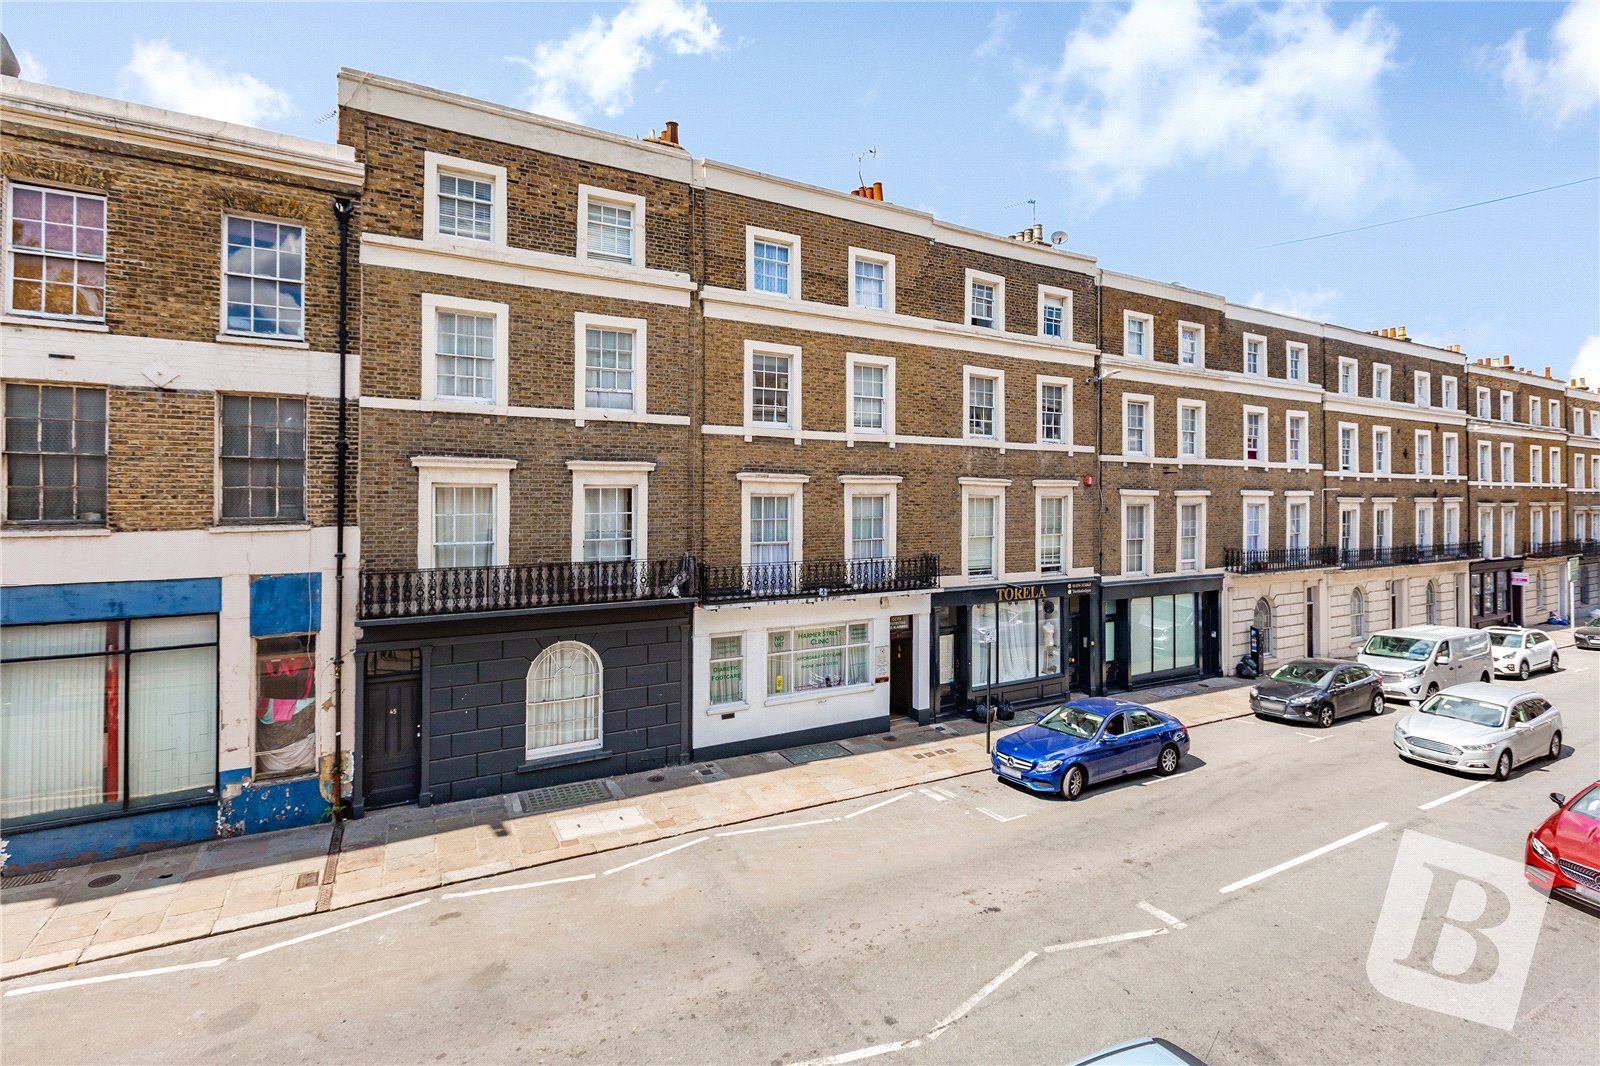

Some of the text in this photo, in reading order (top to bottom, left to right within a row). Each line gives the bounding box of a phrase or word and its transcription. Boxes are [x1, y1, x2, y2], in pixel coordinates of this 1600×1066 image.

[996, 585, 1047, 602] TORELA
[798, 630, 841, 640] HARMER STREET
[810, 638, 830, 646] CLINIC
[713, 665, 739, 673] DIABETIC
[711, 673, 741, 681] FOOTCARE
